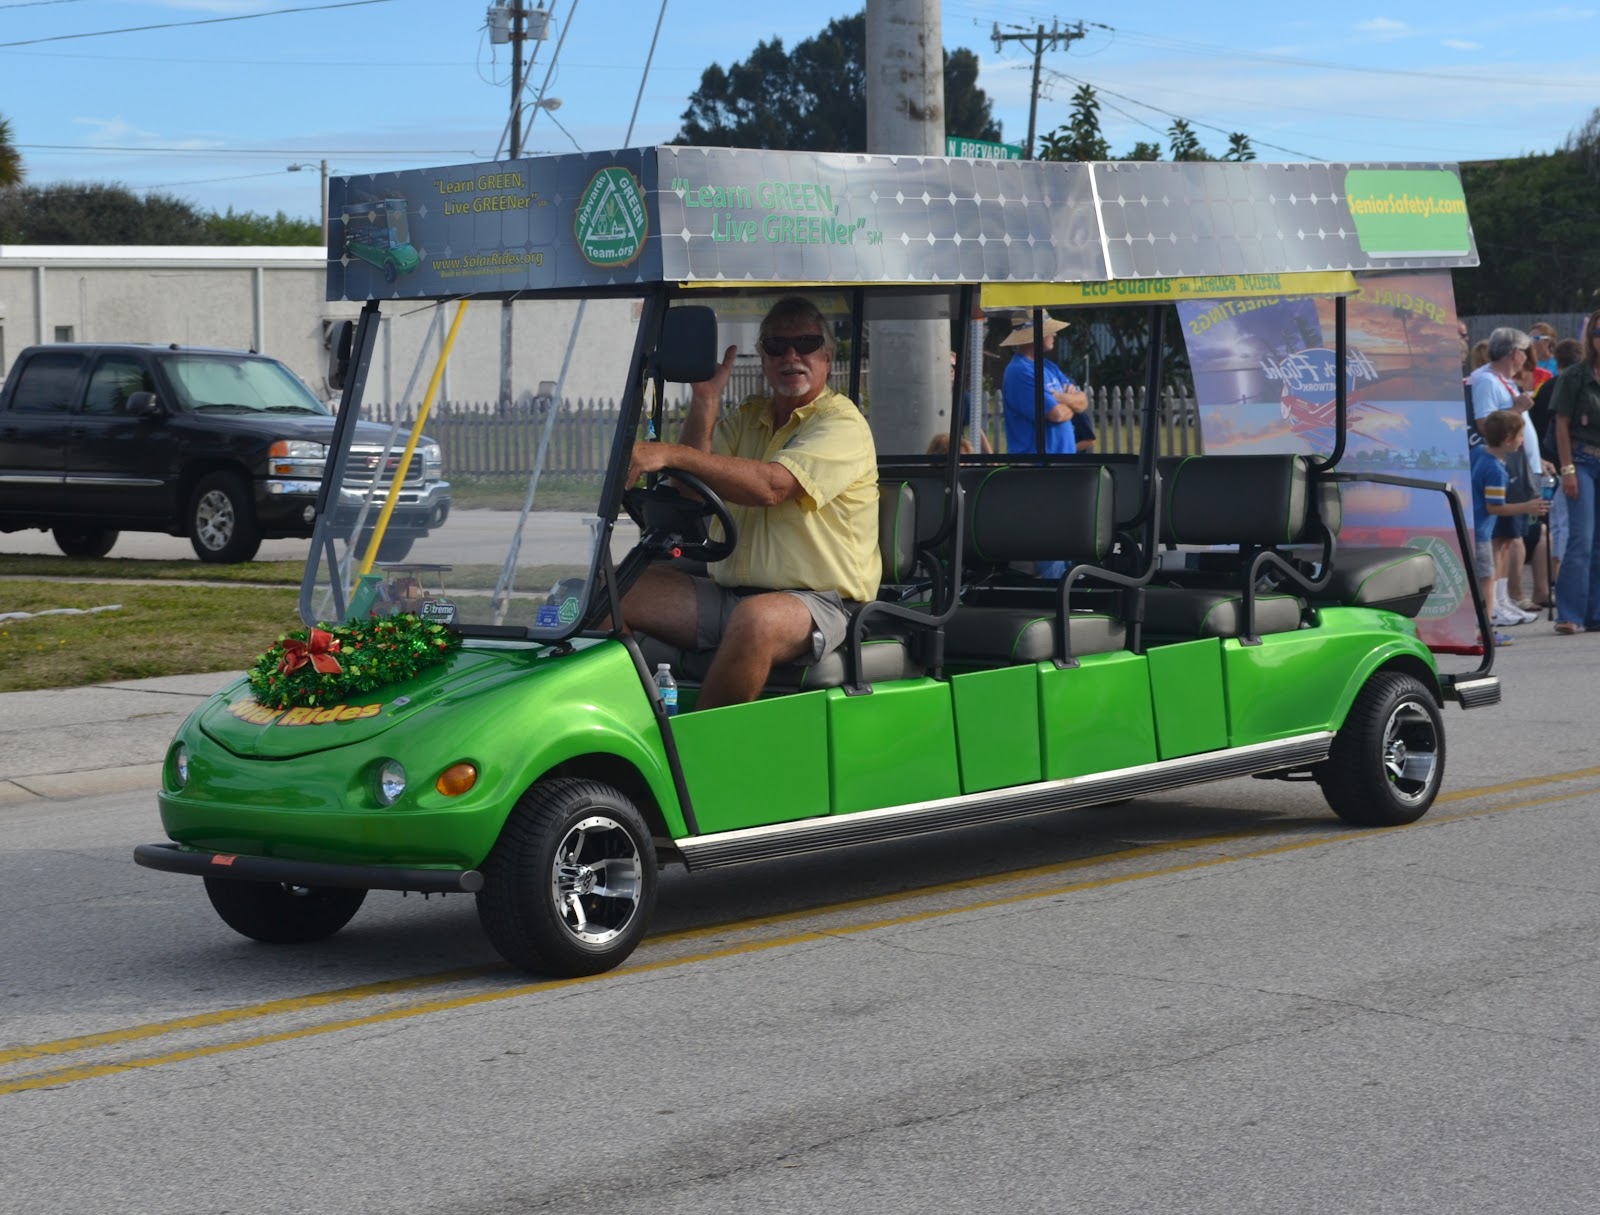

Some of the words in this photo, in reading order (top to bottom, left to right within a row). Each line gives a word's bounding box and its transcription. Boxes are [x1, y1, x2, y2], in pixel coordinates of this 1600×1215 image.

[948, 140, 957, 158] N
[960, 141, 1008, 160] BREVARD
[477, 172, 526, 191] GREEN,
[618, 176, 644, 229] GREEN
[671, 177, 752, 209] "Learn
[756, 180, 839, 216] GREEN,
[443, 199, 470, 216] Live
[712, 212, 758, 243] Live
[866, 230, 883, 246] SM
[432, 251, 544, 270] www.SolarRides.org
[586, 244, 634, 259] Team.org
[276, 703, 383, 727] Rides
